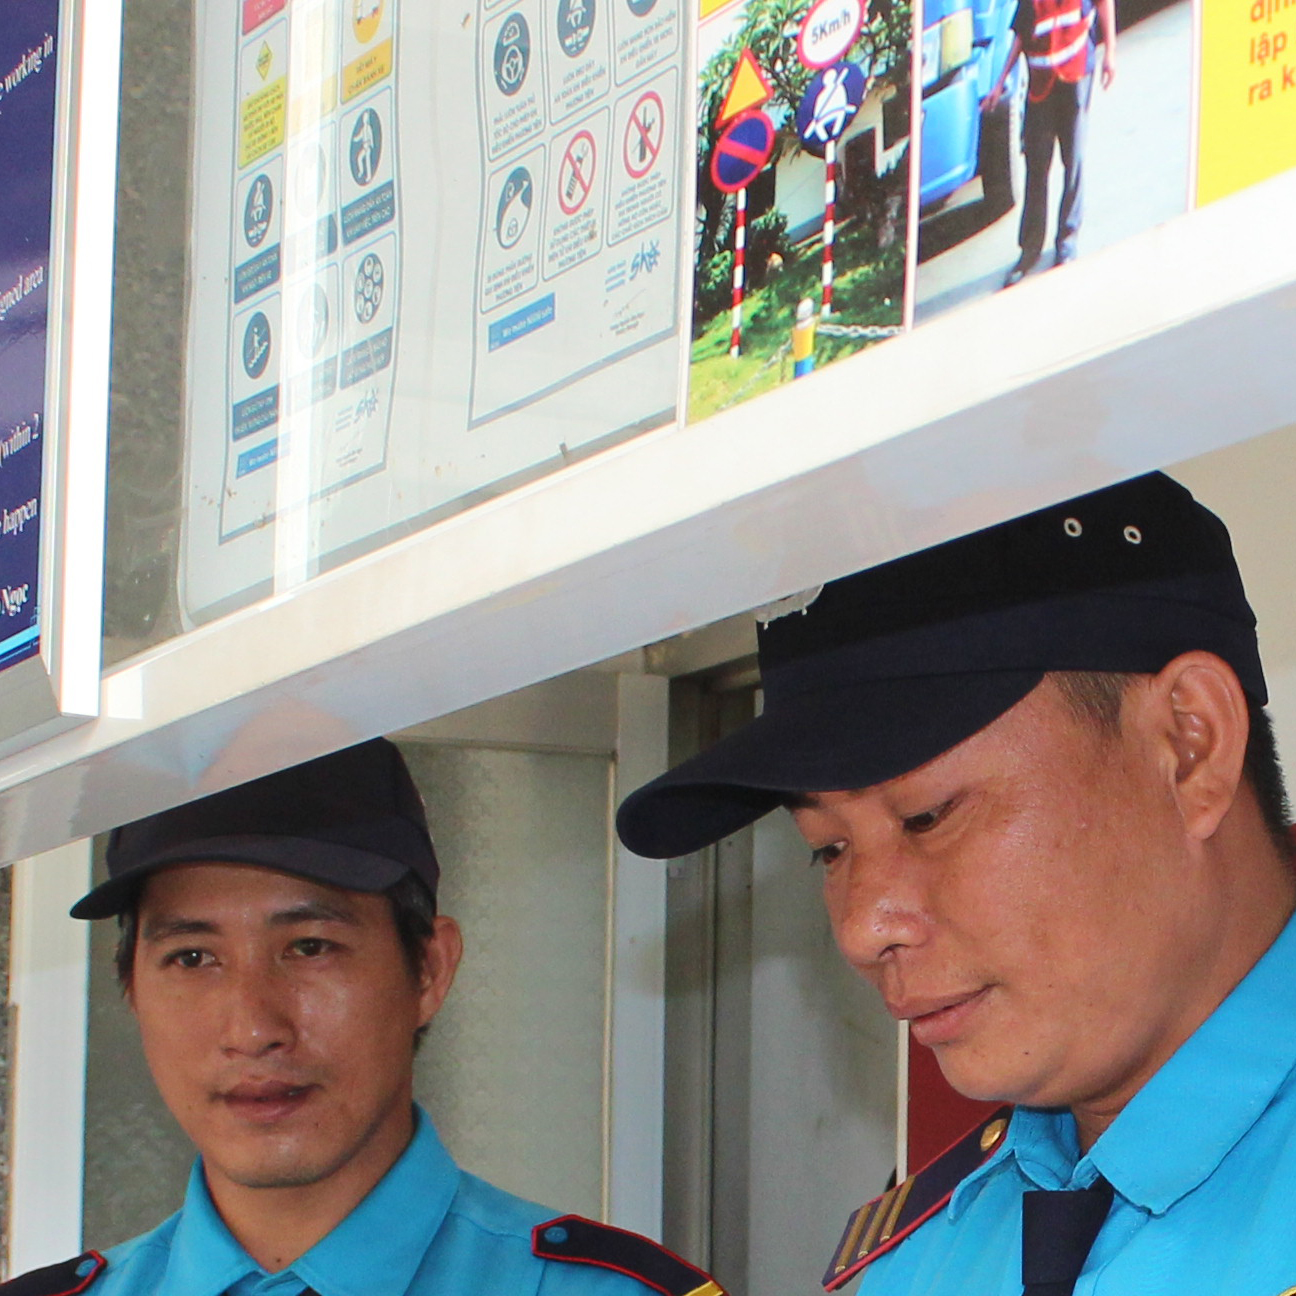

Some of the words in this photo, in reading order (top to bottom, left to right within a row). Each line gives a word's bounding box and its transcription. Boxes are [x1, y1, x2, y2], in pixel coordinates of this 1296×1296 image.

[811, 9, 851, 45] 5Km/h
[1249, 31, 1288, 66] lập
[1248, 78, 1273, 105] ra
